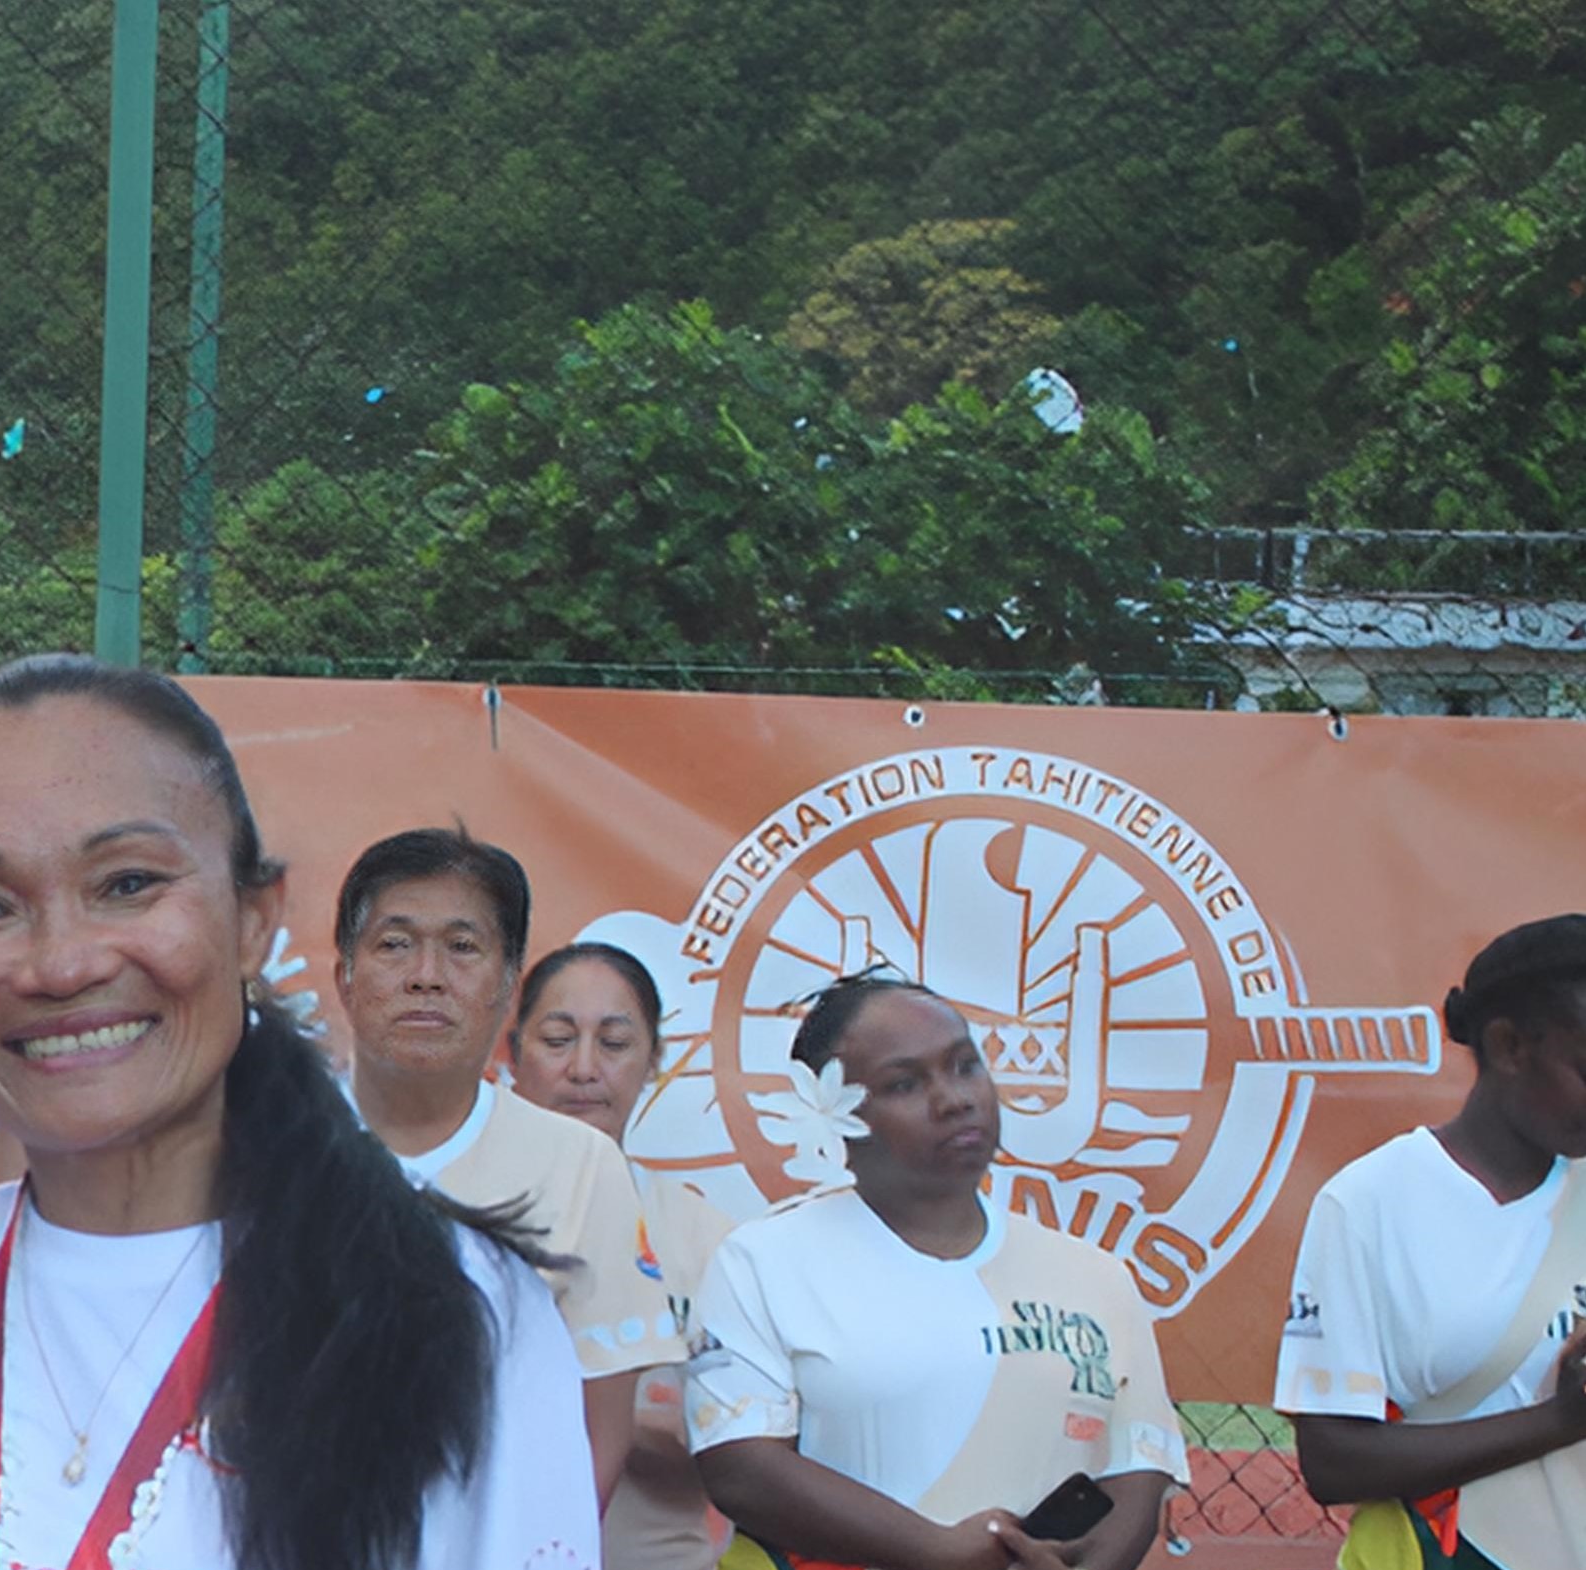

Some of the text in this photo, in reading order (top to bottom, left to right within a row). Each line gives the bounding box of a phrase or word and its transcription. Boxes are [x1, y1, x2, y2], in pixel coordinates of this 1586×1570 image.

[681, 753, 1276, 997] FEDERATION TAHITIENNE DE
[980, 1174, 1207, 1307] NIS
